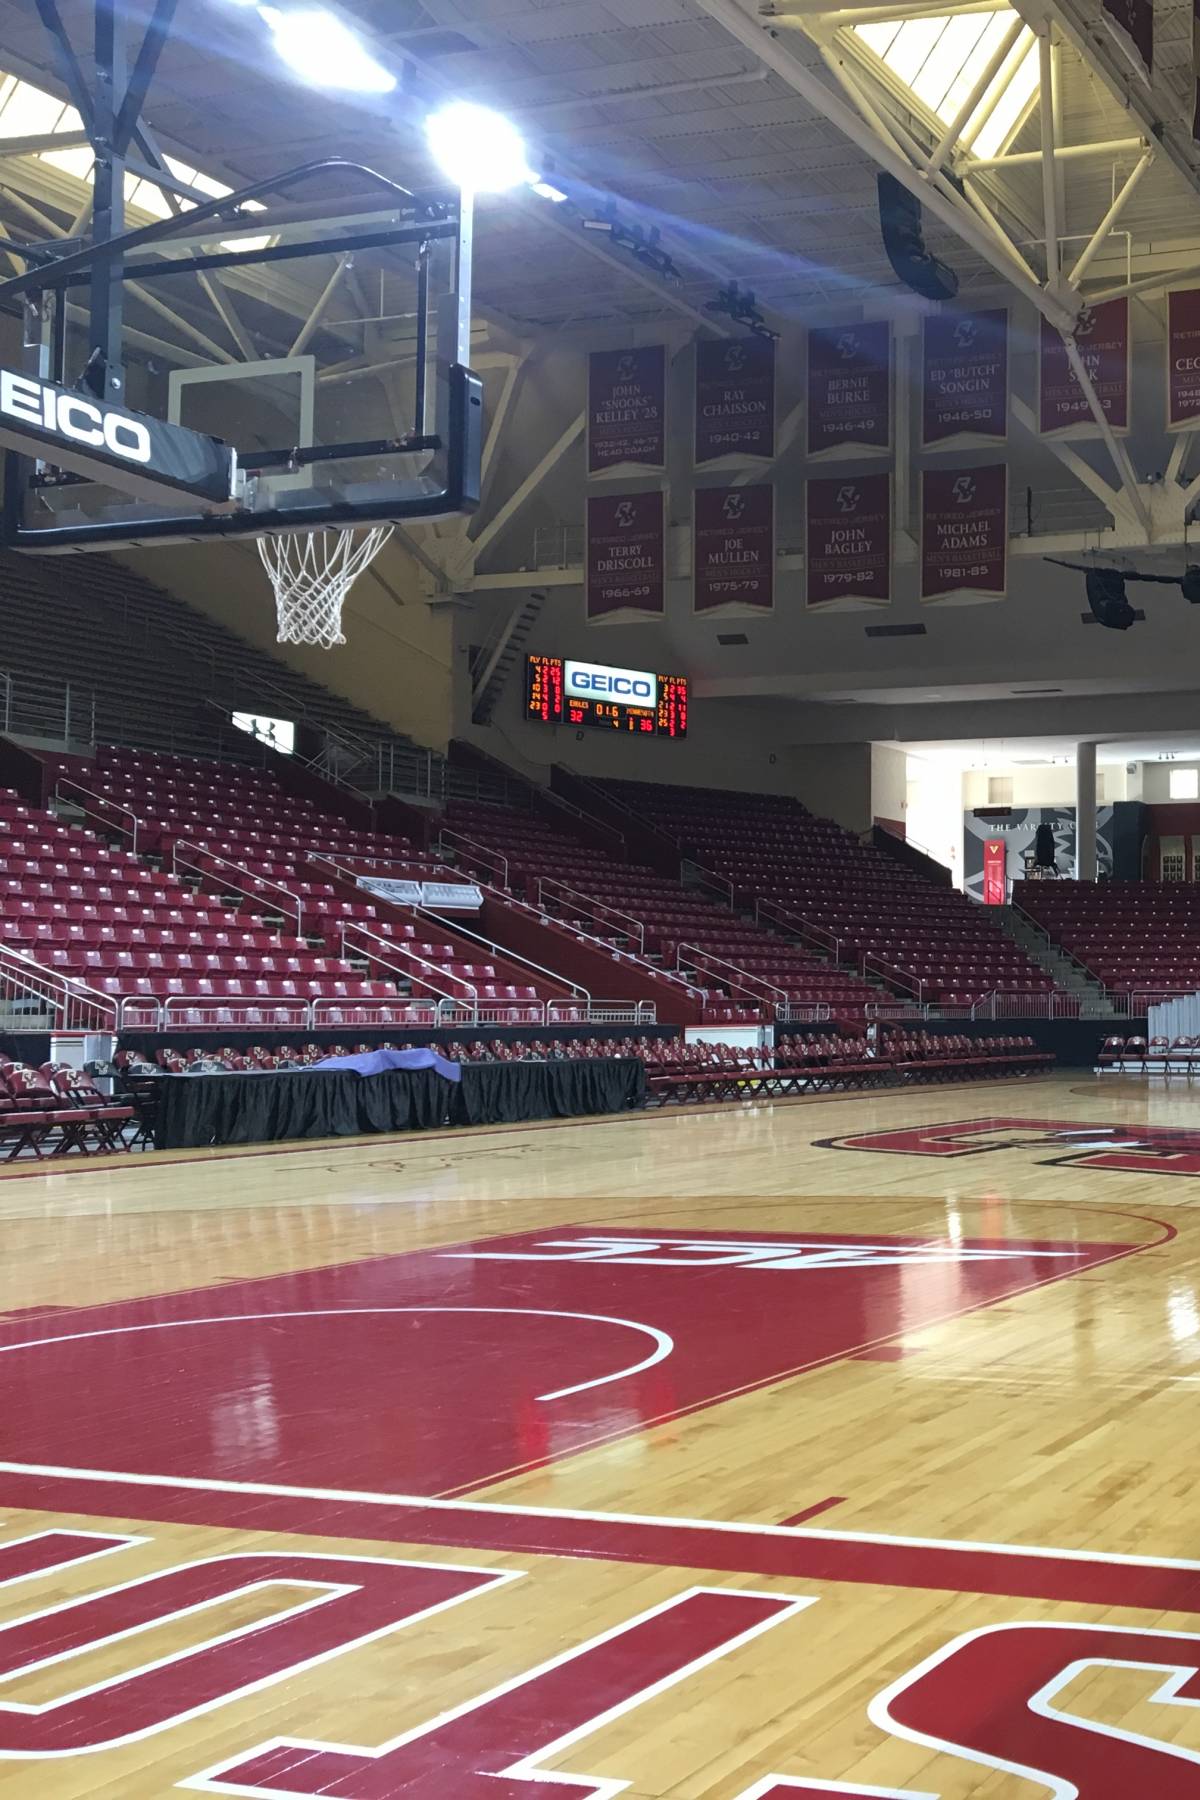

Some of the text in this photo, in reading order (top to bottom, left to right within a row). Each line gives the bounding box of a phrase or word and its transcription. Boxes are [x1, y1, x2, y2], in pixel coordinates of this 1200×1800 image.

[930, 370, 945, 381] ED
[1069, 368, 1098, 382] SK
[828, 377, 869, 390] BERNIE
[940, 378, 990, 393] SONGIN
[613, 385, 640, 400] JOHN
[724, 390, 745, 400] RAY
[826, 391, 871, 404] BURKE
[703, 401, 767, 416] CHAISSON
[596, 410, 639, 423] KELLEY
[823, 420, 875, 432] 1946-49
[937, 520, 991, 535] MICHAEL
[831, 529, 865, 543] JOHN
[941, 534, 988, 549] ADAMS
[608, 545, 642, 557] TERRY
[724, 538, 744, 552] JOE
[824, 541, 872, 554] BAGLEY
[597, 557, 655, 571] DRISCOLL
[708, 551, 759, 564] MULLEN
[823, 571, 874, 583] 1979-82
[938, 565, 989, 577] 1981-85
[709, 580, 759, 592] 1975-79
[571, 672, 651, 697] GEICO
[570, 709, 584, 723] 32
[640, 718, 654, 732] 36
[990, 823, 1011, 832] THE
